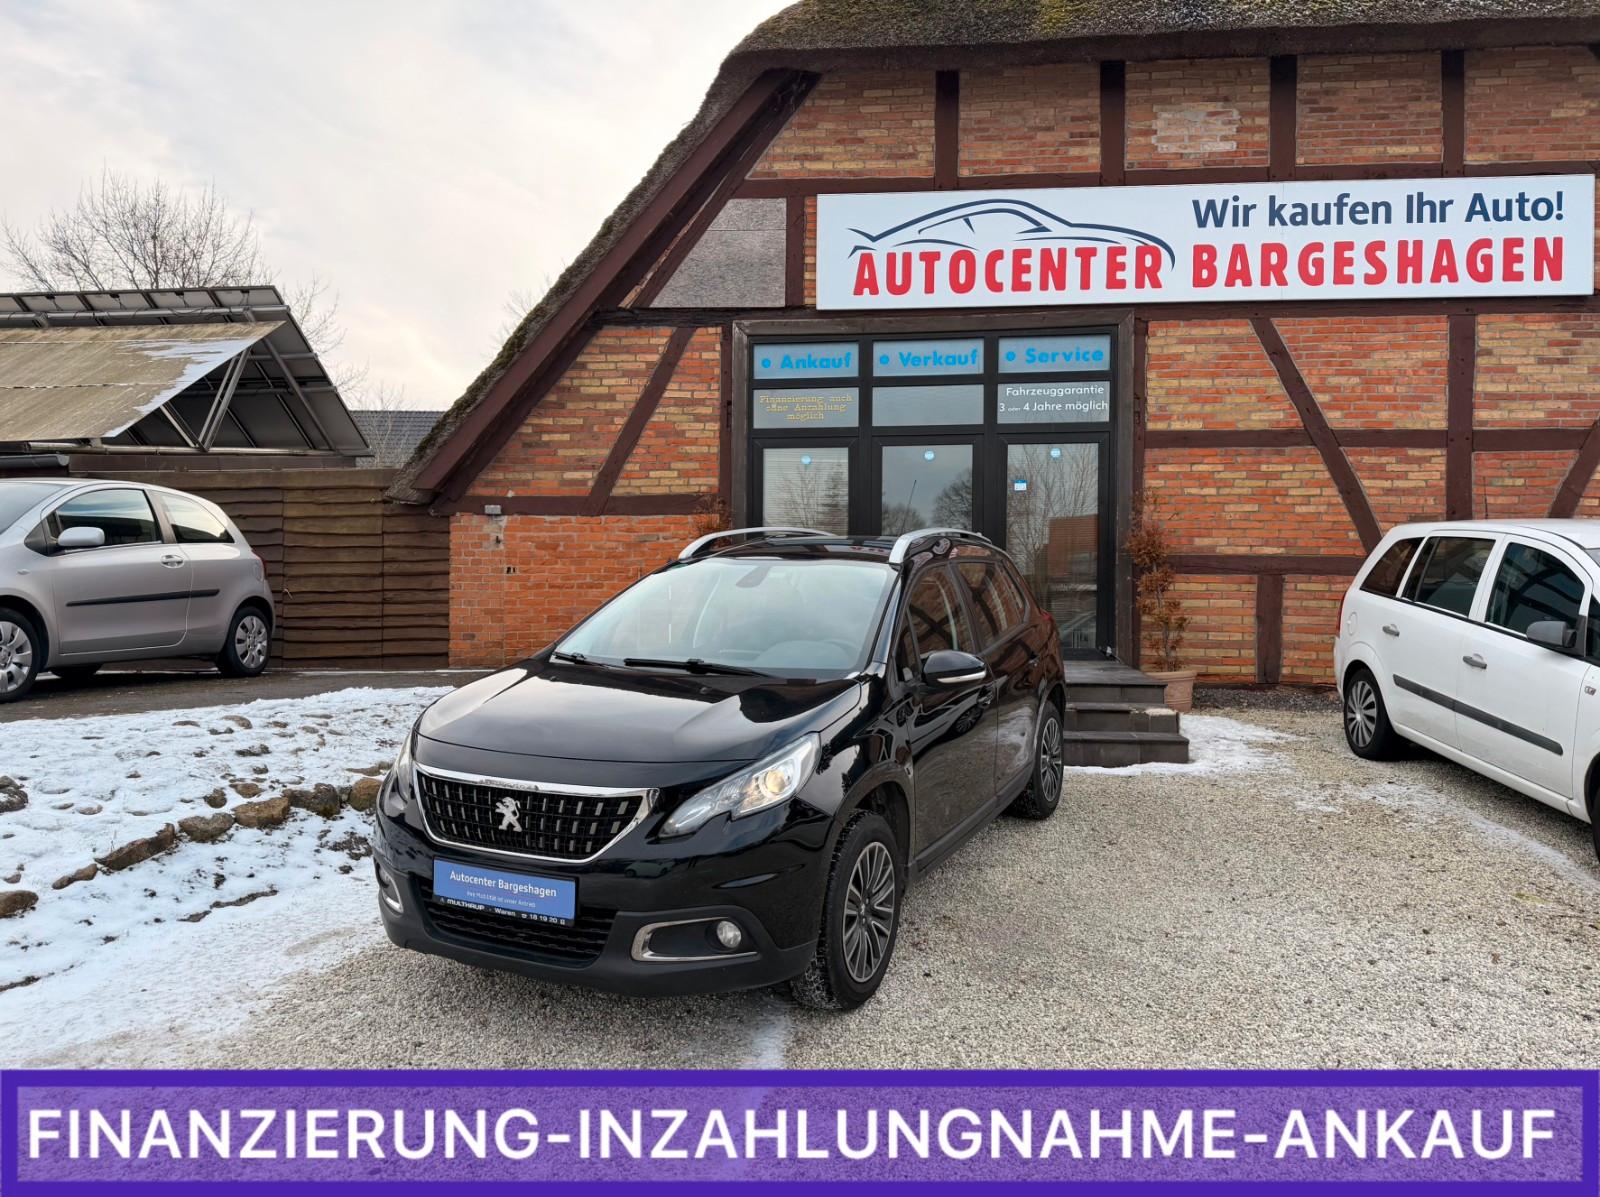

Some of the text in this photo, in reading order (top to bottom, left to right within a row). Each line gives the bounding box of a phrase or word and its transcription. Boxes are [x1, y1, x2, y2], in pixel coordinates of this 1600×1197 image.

[1192, 190, 1564, 228] Wir kaufen Ihr Auto!
[854, 238, 1563, 295] AUTOCENTER BARGESHAGEN
[780, 351, 852, 369] Ankauf
[899, 349, 978, 368] Verkauf
[1025, 347, 1104, 364] Service
[1006, 385, 1105, 397] Fahrzeuggarantie
[1000, 402, 1006, 412] 3
[1023, 402, 1031, 411] 4
[1032, 402, 1062, 411] Jahre
[1065, 400, 1109, 412] möglich
[450, 870, 557, 898] Autocenter Bargeshagen
